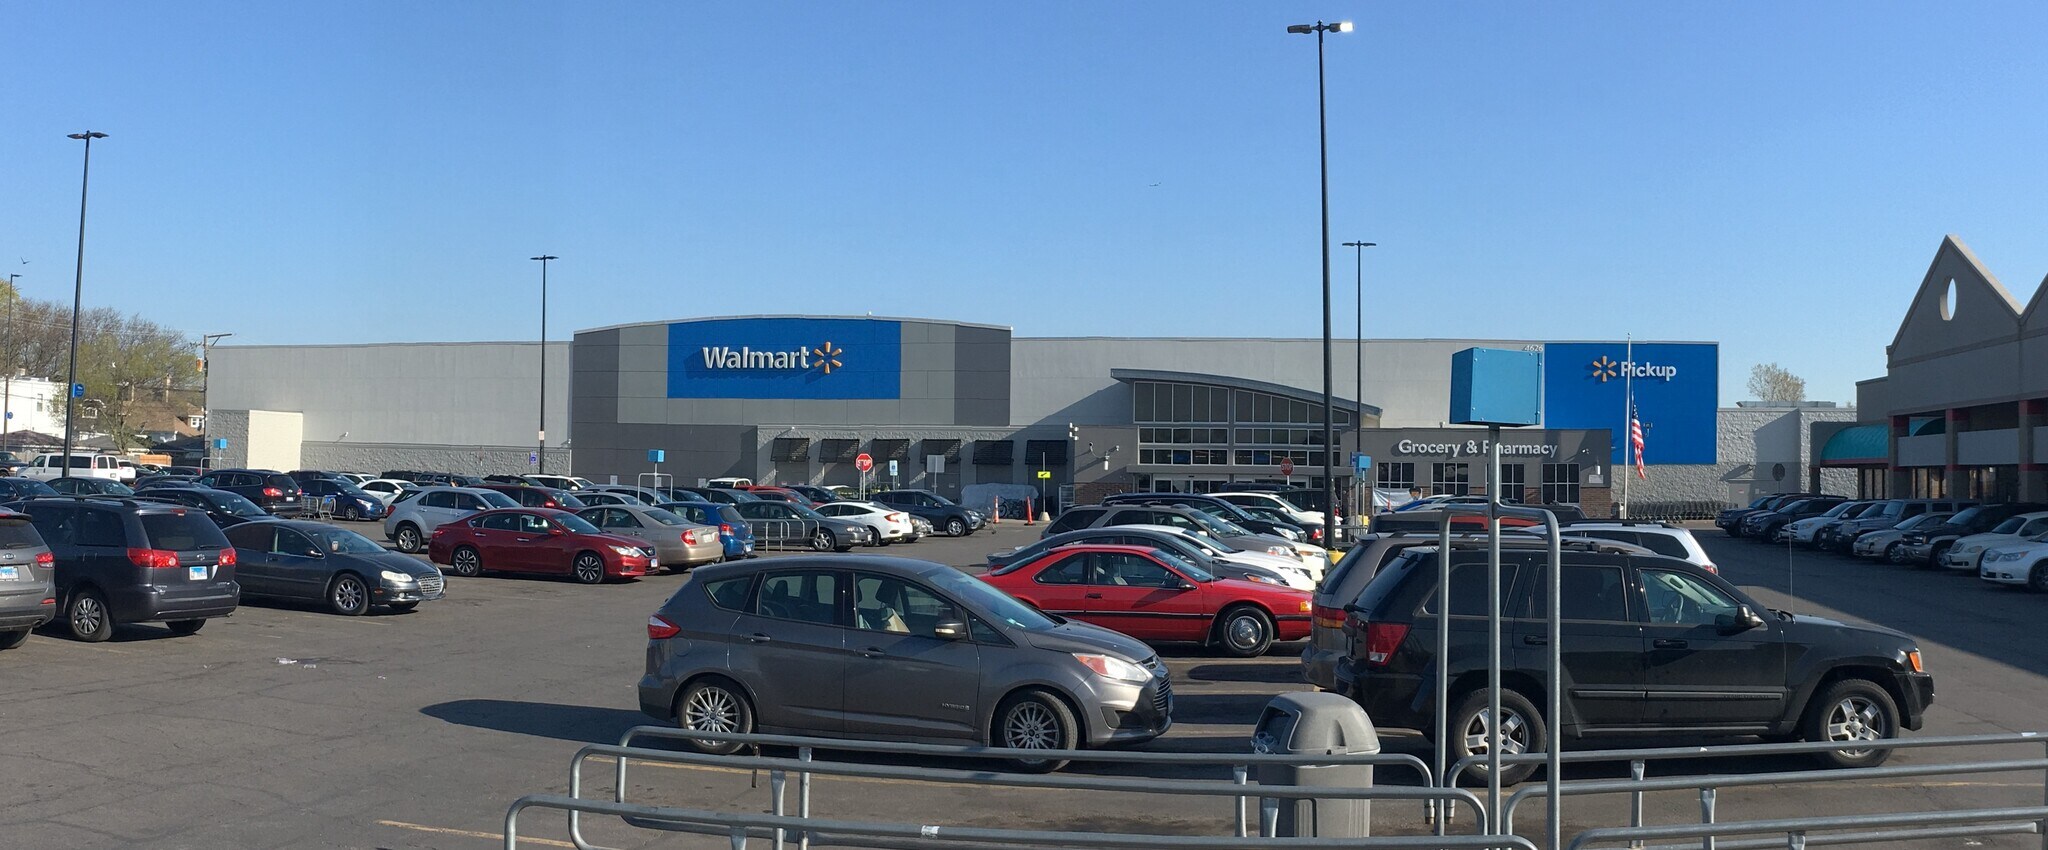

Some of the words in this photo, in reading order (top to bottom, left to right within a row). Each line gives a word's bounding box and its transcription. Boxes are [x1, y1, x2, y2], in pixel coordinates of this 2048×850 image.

[1524, 344, 1543, 352] 4626
[702, 346, 809, 369] Walmart
[1620, 361, 1676, 381] Pickup
[1398, 439, 1460, 458] Grocery
[1466, 440, 1478, 454] &
[857, 459, 871, 467] STOP
[1281, 463, 1293, 471] STOP
